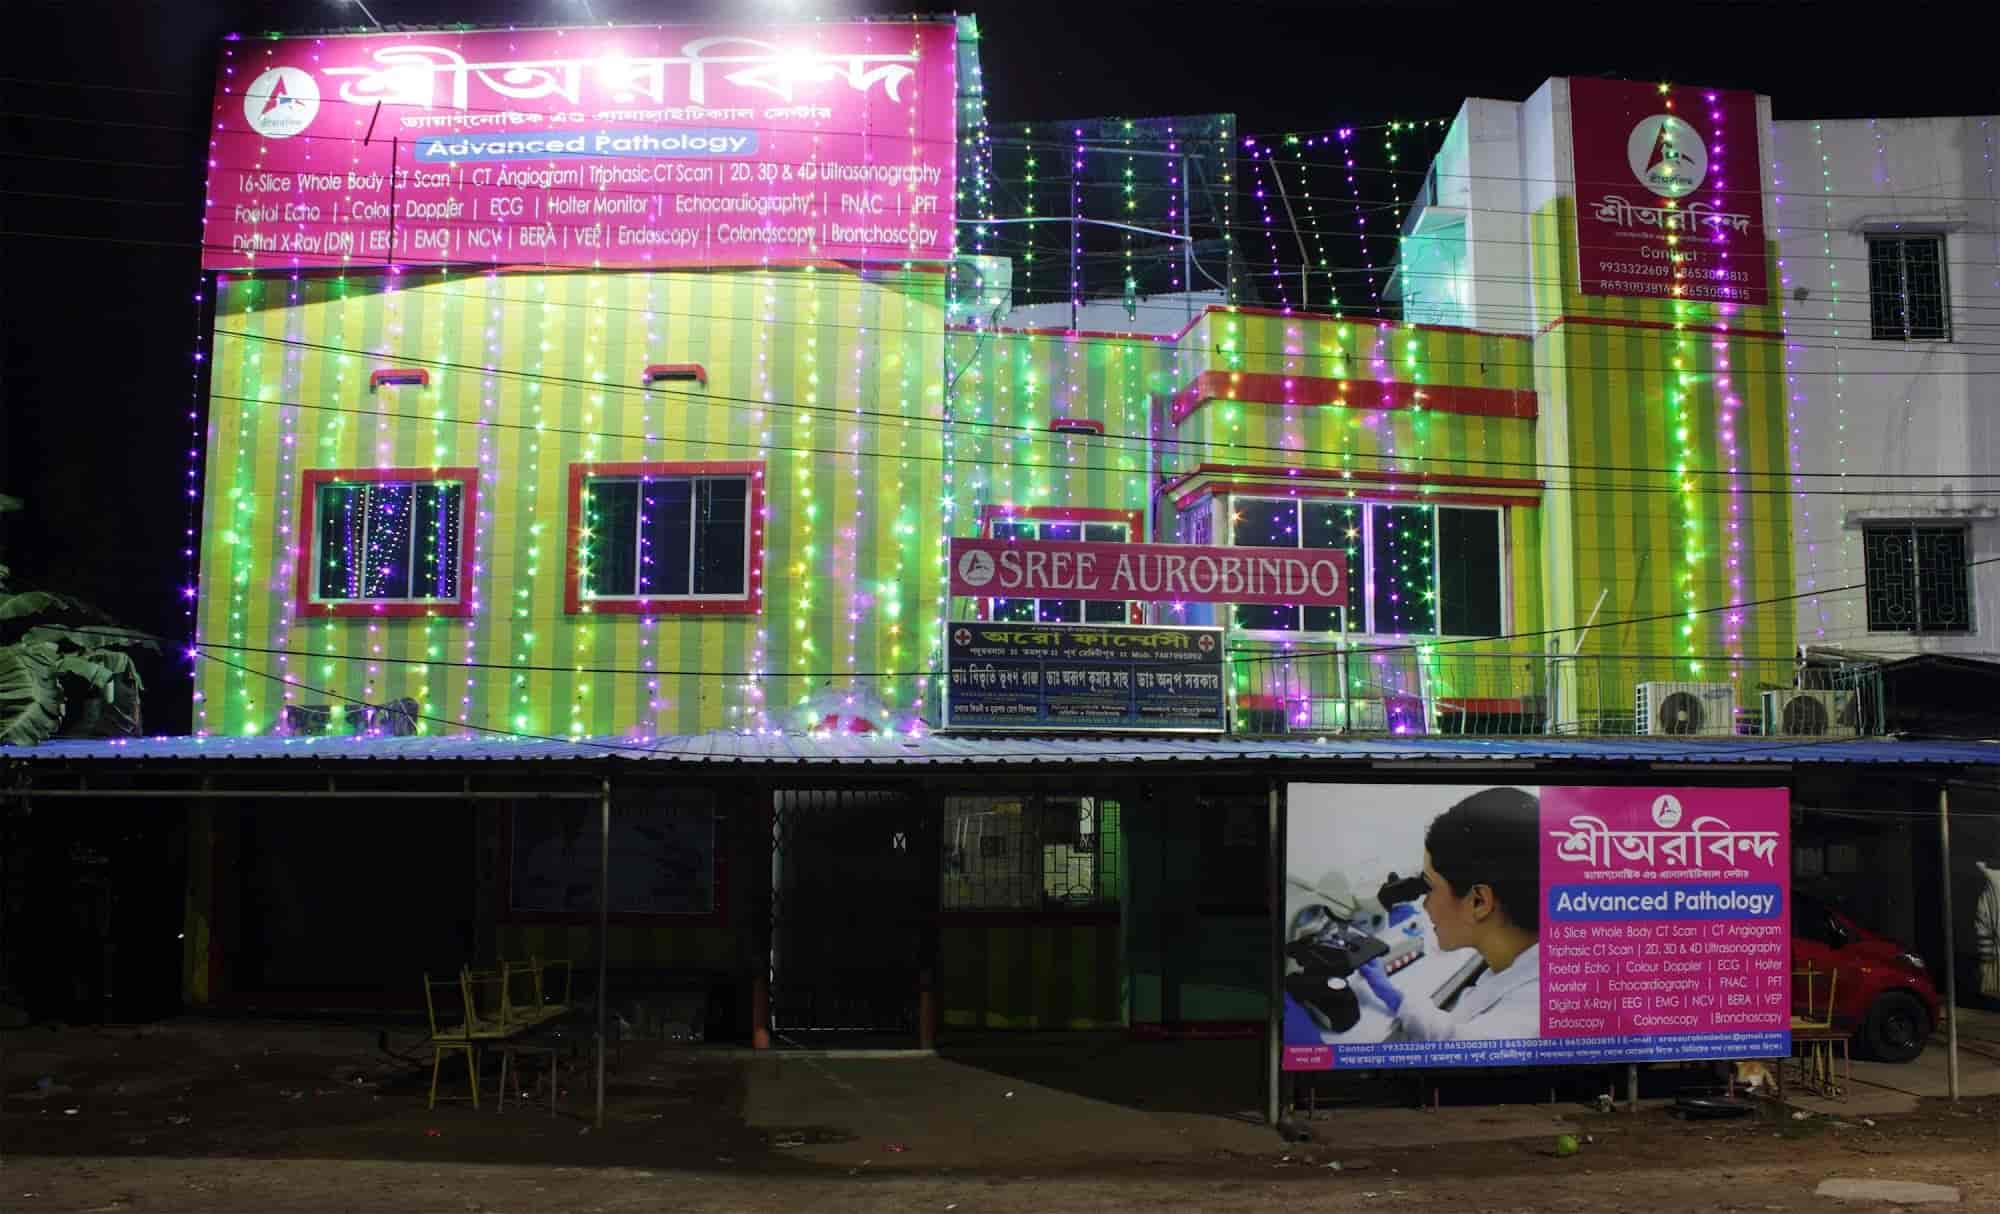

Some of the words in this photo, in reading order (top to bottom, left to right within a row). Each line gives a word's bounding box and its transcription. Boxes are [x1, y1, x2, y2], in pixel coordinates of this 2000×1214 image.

[426, 135, 585, 156] Advanced
[595, 134, 747, 153] Pathology
[298, 172, 341, 192] Whole
[348, 171, 384, 192] Body
[414, 170, 450, 188] Scan
[472, 168, 491, 186] CT
[498, 167, 578, 189] Angiogram
[589, 164, 650, 185] Triphasic
[654, 164, 673, 182] CT
[676, 164, 713, 182] Scan
[759, 163, 777, 181] 3D
[782, 164, 792, 180] &
[797, 162, 816, 180] 4D
[821, 161, 941, 186] Ultrasonography
[234, 203, 279, 224] Foetal
[285, 202, 320, 222] Echo
[406, 199, 464, 222] Doppler
[490, 197, 523, 216] ECG
[549, 195, 591, 215] Holter
[593, 194, 648, 214] Monitor
[676, 192, 809, 216] Echocardiography
[842, 193, 883, 214] FNAC
[914, 195, 937, 213] PFT
[1590, 195, 1751, 235] শ্রীঅরবিন্দ
[281, 231, 321, 253] X-Ray
[369, 230, 398, 250] EEG
[415, 228, 448, 249] EMG
[468, 228, 502, 247] NCV
[519, 226, 557, 247] BERA
[618, 226, 699, 248] Endoscopy
[717, 223, 816, 248] Colonoscopy
[832, 223, 937, 246] Bronchoscopy
[1000, 549, 1099, 590] SREE
[1111, 554, 1339, 597] AUROBINDO
[1549, 816, 1780, 868] শ্রীঅরবিন্দ
[1556, 891, 1668, 912] Advanced
[1674, 889, 1774, 914] Pathology
[1549, 927, 1560, 938] 16
[1564, 926, 1586, 938] Slice
[1591, 926, 1622, 937] Whole
[1627, 926, 1652, 939] Body
[1656, 925, 1669, 937] CT
[1672, 925, 1697, 937] Scan
[1711, 924, 1725, 936] CT
[1728, 924, 1782, 938] Angiogram
[1548, 943, 1590, 957] Triphasic
[1592, 943, 1606, 955] CT
[1608, 943, 1634, 956] Scan
[1663, 943, 1677, 954] 3D
[1680, 943, 1688, 954] &
[1690, 942, 1702, 954] 4D
[1704, 941, 1782, 955] Ultrasonography
[1548, 961, 1580, 975] Foetal
[1584, 961, 1610, 974] Echo
[1626, 960, 1659, 973] Colour
[1663, 960, 1702, 974] Doppler
[1718, 959, 1740, 970] ECG
[1755, 958, 1782, 970] Holter
[1548, 980, 1587, 993] Monitor
[1608, 978, 1699, 993] Echocardiography
[1719, 976, 1747, 988] FNAC
[1548, 998, 1580, 1013] Digital
[1584, 997, 1611, 1012] X-Ray
[1622, 997, 1642, 1009] EEG
[1655, 996, 1680, 1008] EMG
[1692, 994, 1714, 1007] NCV
[1727, 993, 1752, 1006] BERA
[1764, 993, 1782, 1005] VEP
[1548, 1017, 1605, 1031] Endoscopy
[1632, 1014, 1698, 1027] Colonoscopy
[1715, 1011, 1783, 1025] Bronchoscopy
